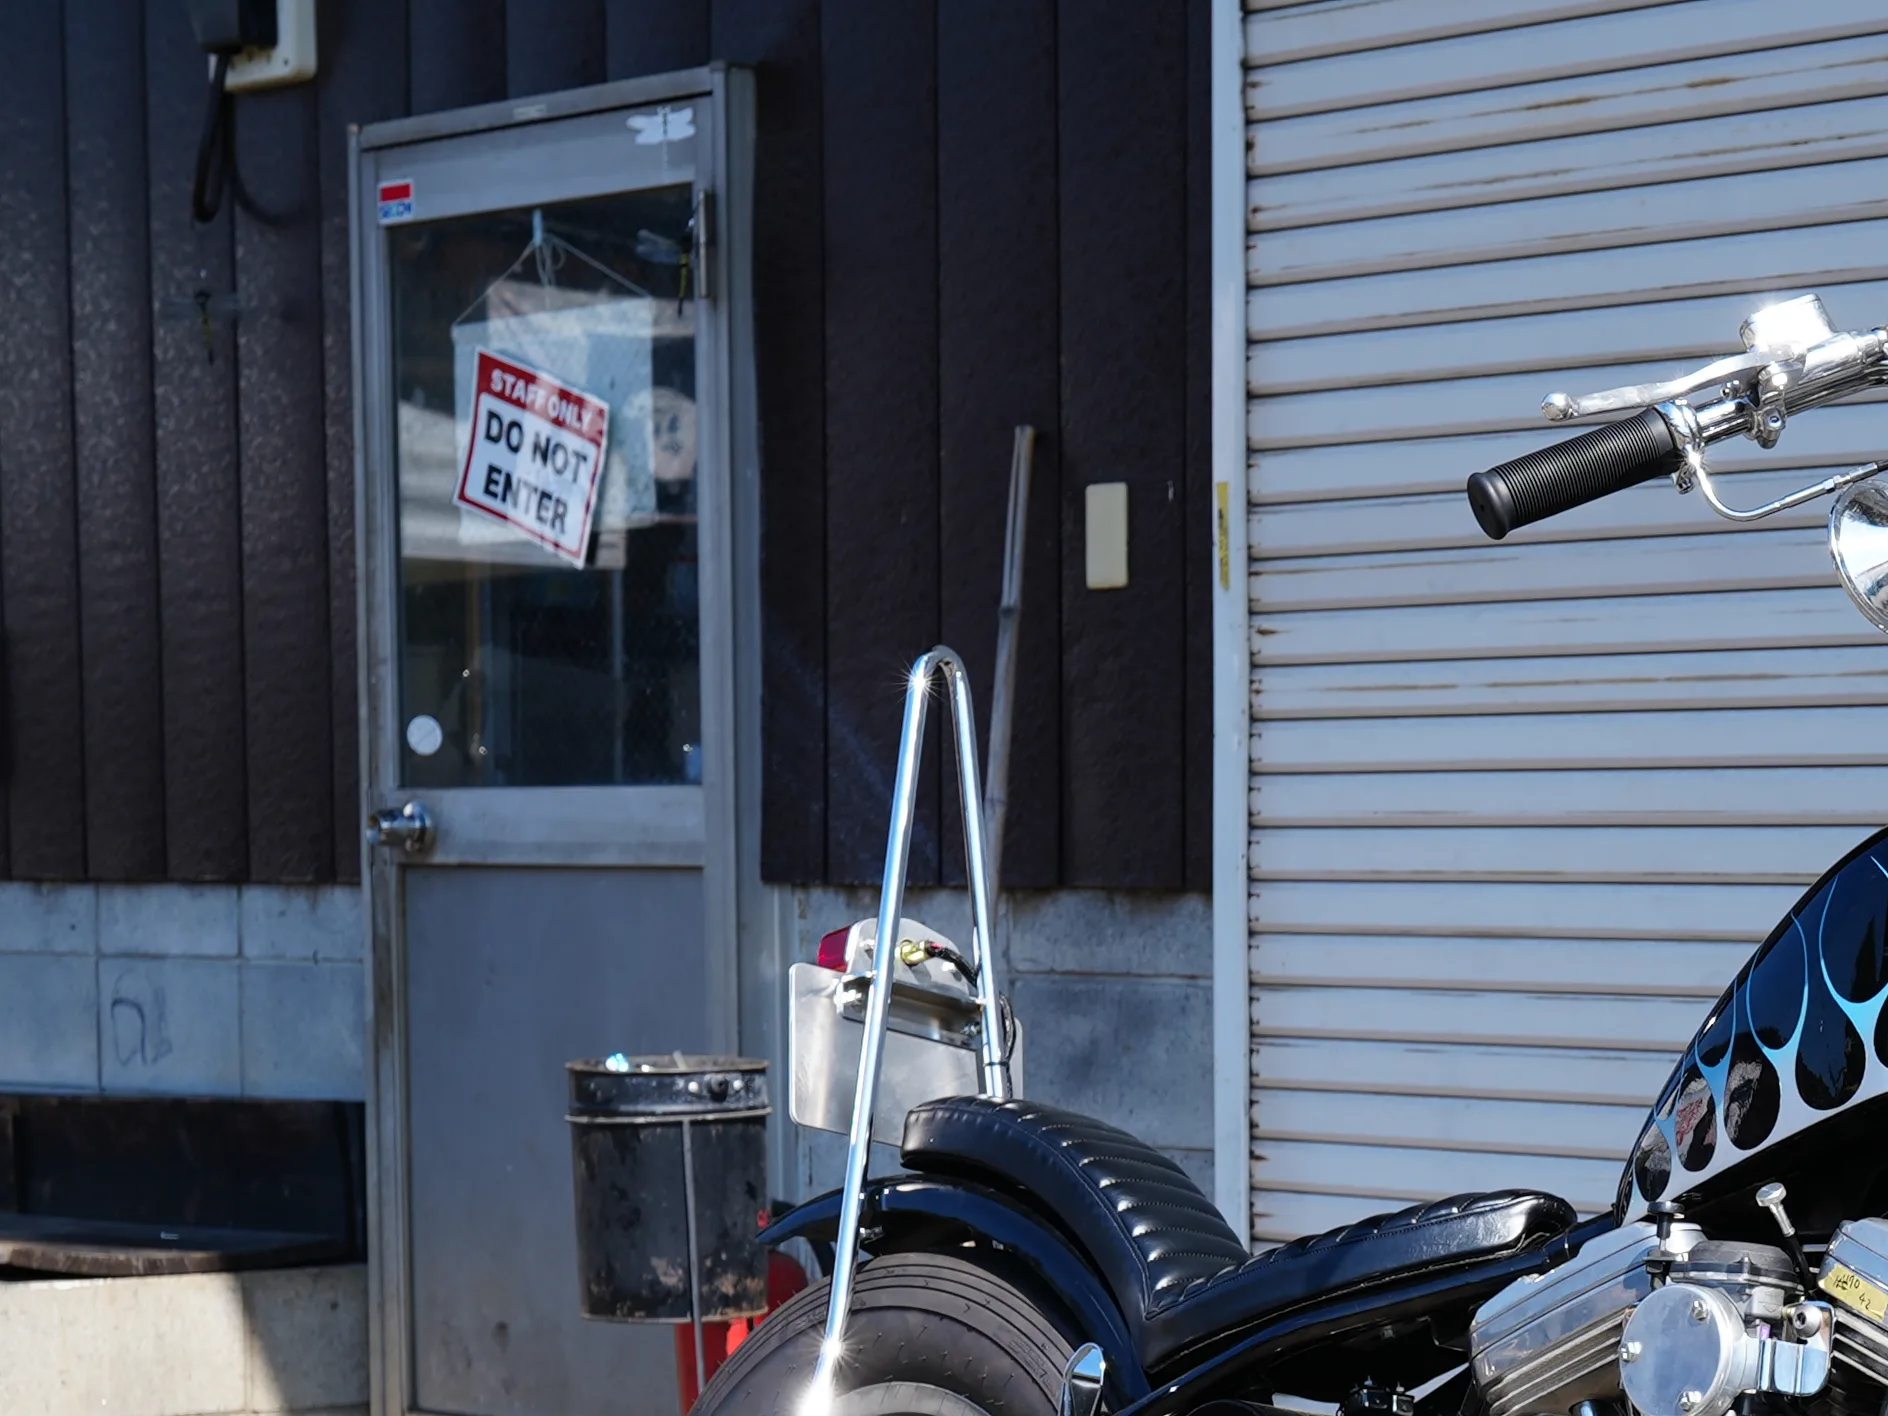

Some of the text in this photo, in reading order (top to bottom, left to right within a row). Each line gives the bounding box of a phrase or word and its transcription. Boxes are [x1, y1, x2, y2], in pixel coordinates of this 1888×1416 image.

[490, 369, 593, 434] STAFF ONLY
[485, 409, 588, 484] DO NOT
[483, 464, 569, 535] ENTER
